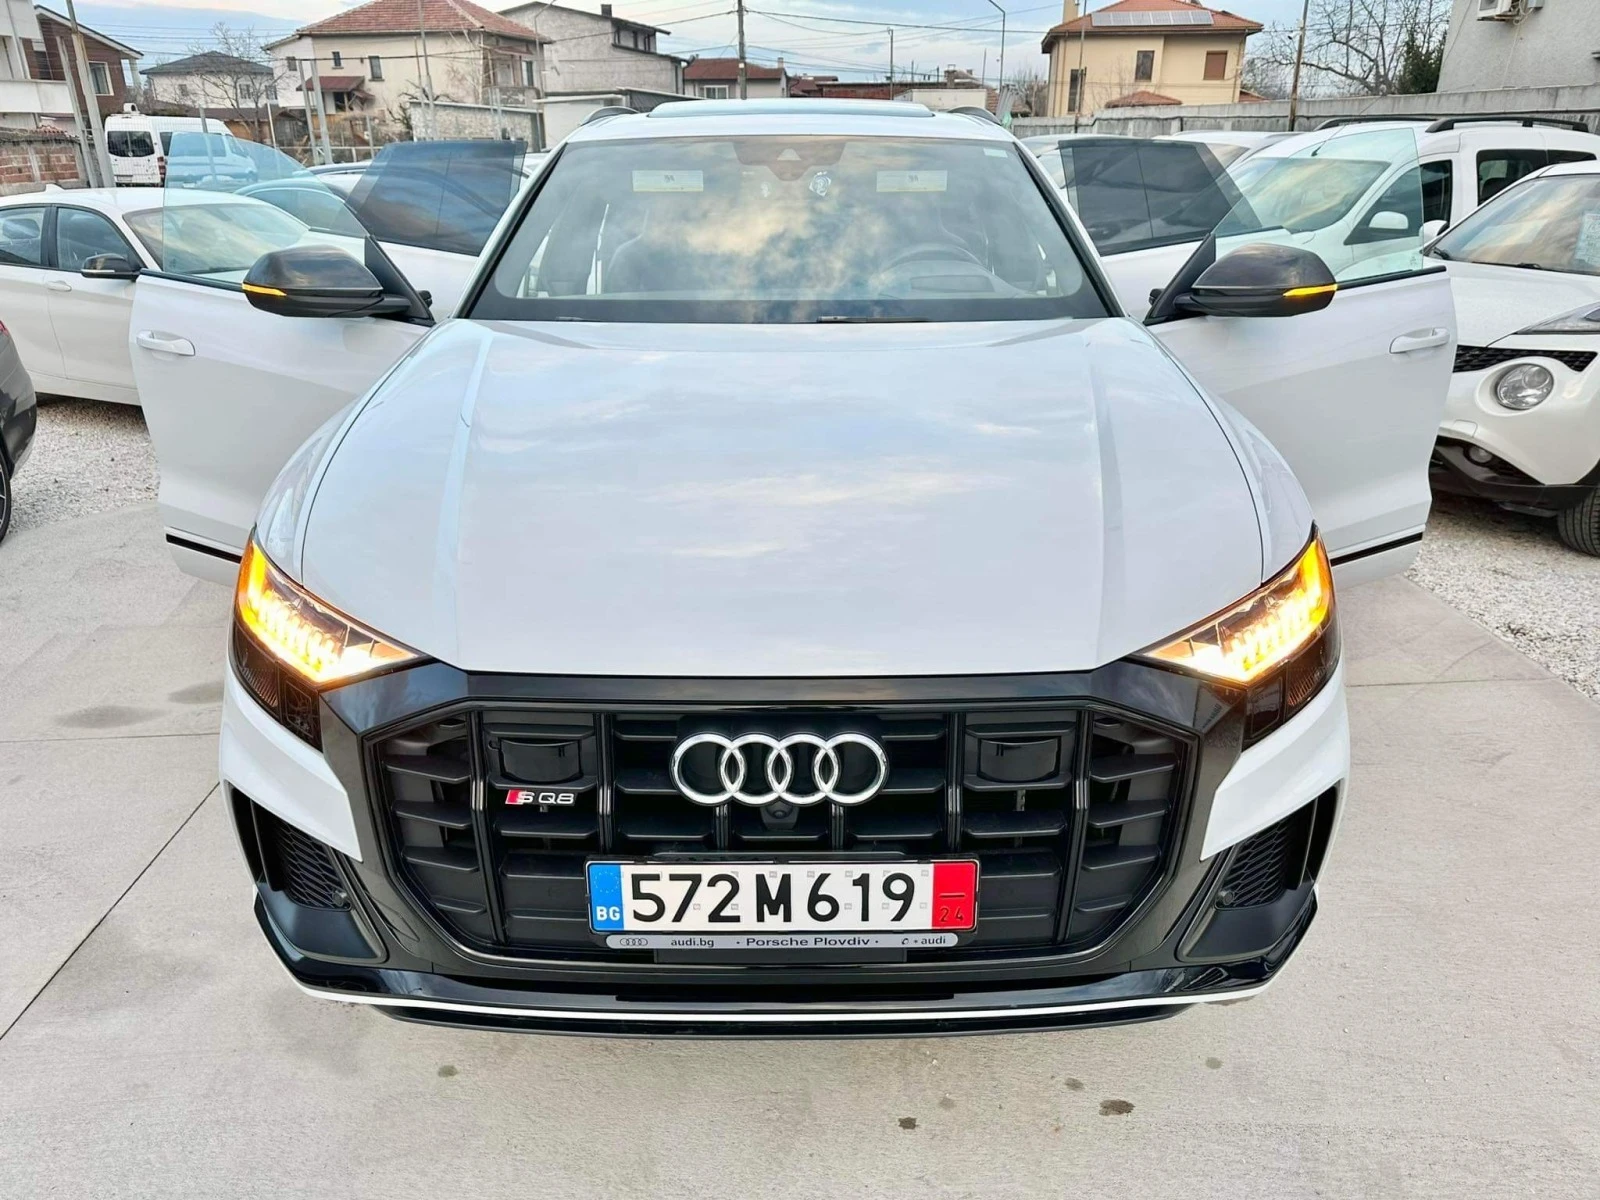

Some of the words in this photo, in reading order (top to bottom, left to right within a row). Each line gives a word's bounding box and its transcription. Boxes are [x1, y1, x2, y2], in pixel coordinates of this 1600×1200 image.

[631, 873, 741, 923] 572
[807, 872, 915, 923] 619
[595, 906, 621, 921] BG
[939, 906, 964, 923] 24
[670, 937, 715, 948] audi.bg
[746, 937, 809, 947] Porsche
[813, 936, 870, 946] Plovdiv
